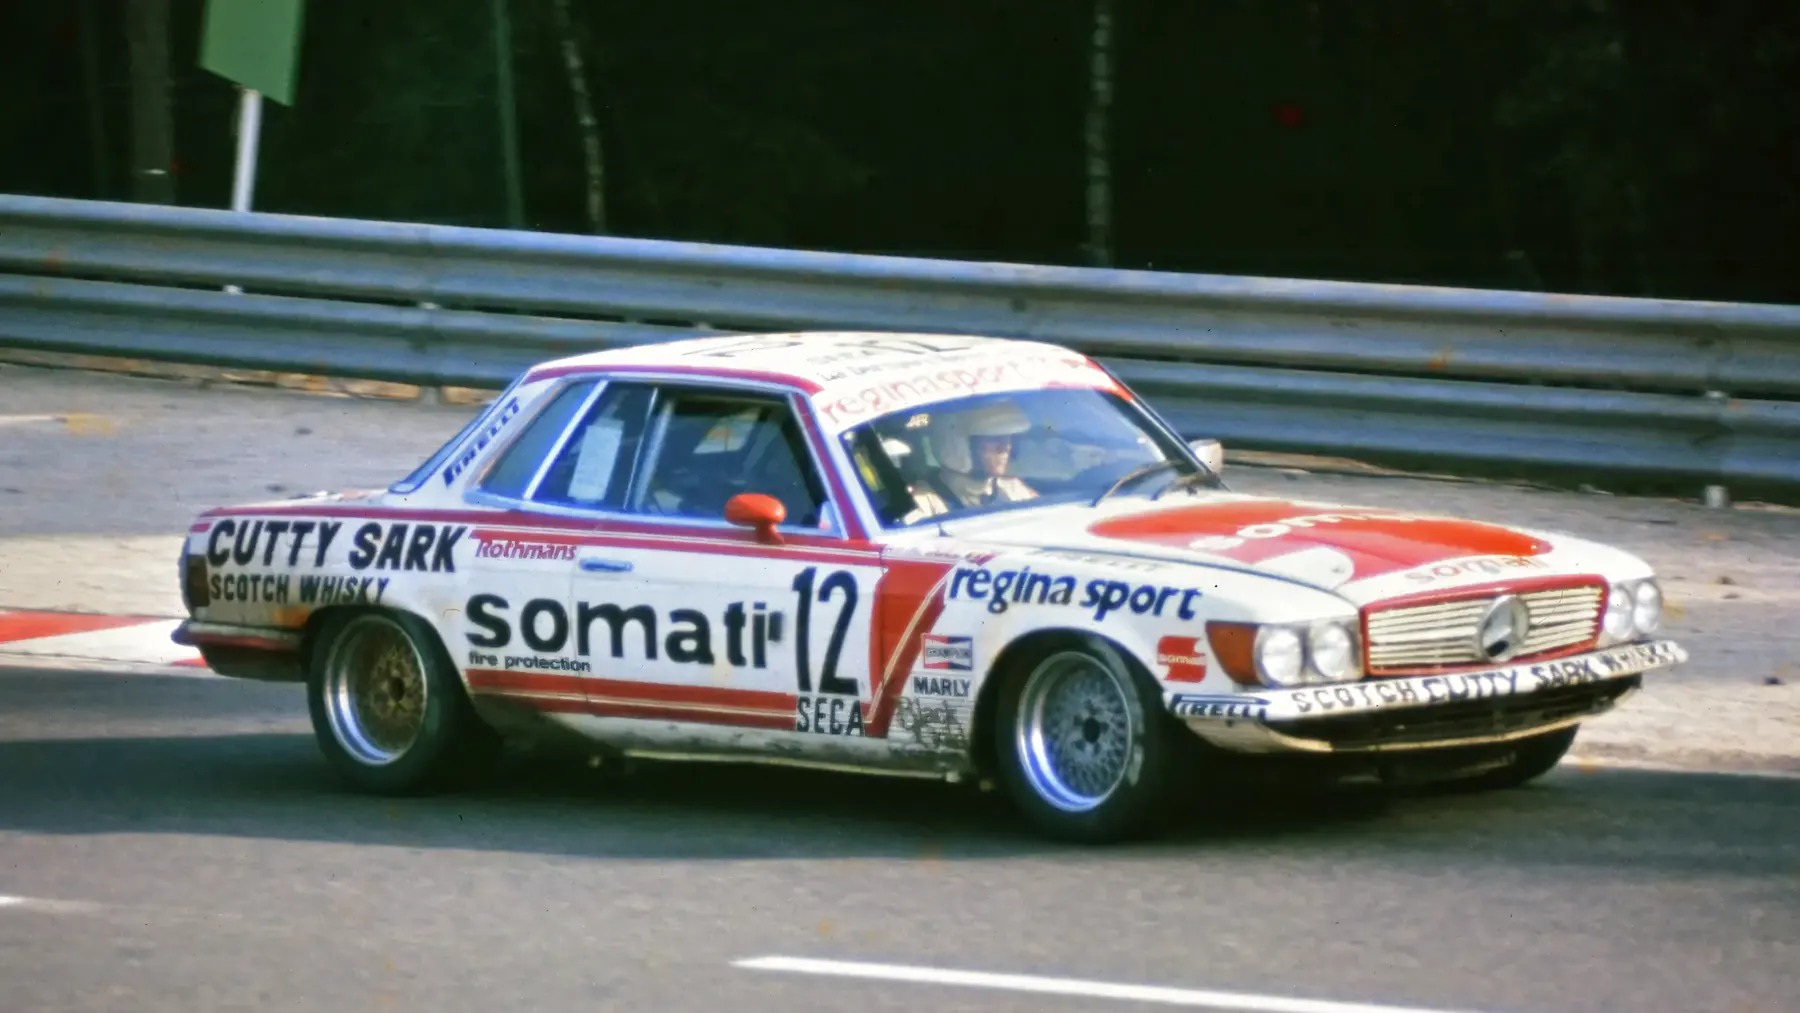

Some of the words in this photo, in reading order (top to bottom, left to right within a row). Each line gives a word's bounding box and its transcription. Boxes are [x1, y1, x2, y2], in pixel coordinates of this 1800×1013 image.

[207, 518, 341, 567] CUTTY
[349, 520, 467, 573] SARK
[475, 539, 577, 561] Rothmans
[210, 574, 289, 602] SCOTCH
[300, 576, 390, 604] WHISKY
[950, 565, 1077, 614] regina
[1079, 578, 1203, 621] sport
[792, 566, 859, 696] 12
[468, 651, 498, 667] fire
[504, 654, 591, 672] protection
[913, 676, 971, 698] MARLY
[1290, 678, 1418, 713] SCOTCH
[1422, 668, 1518, 705] CUTTY
[797, 696, 866, 737] SECA
